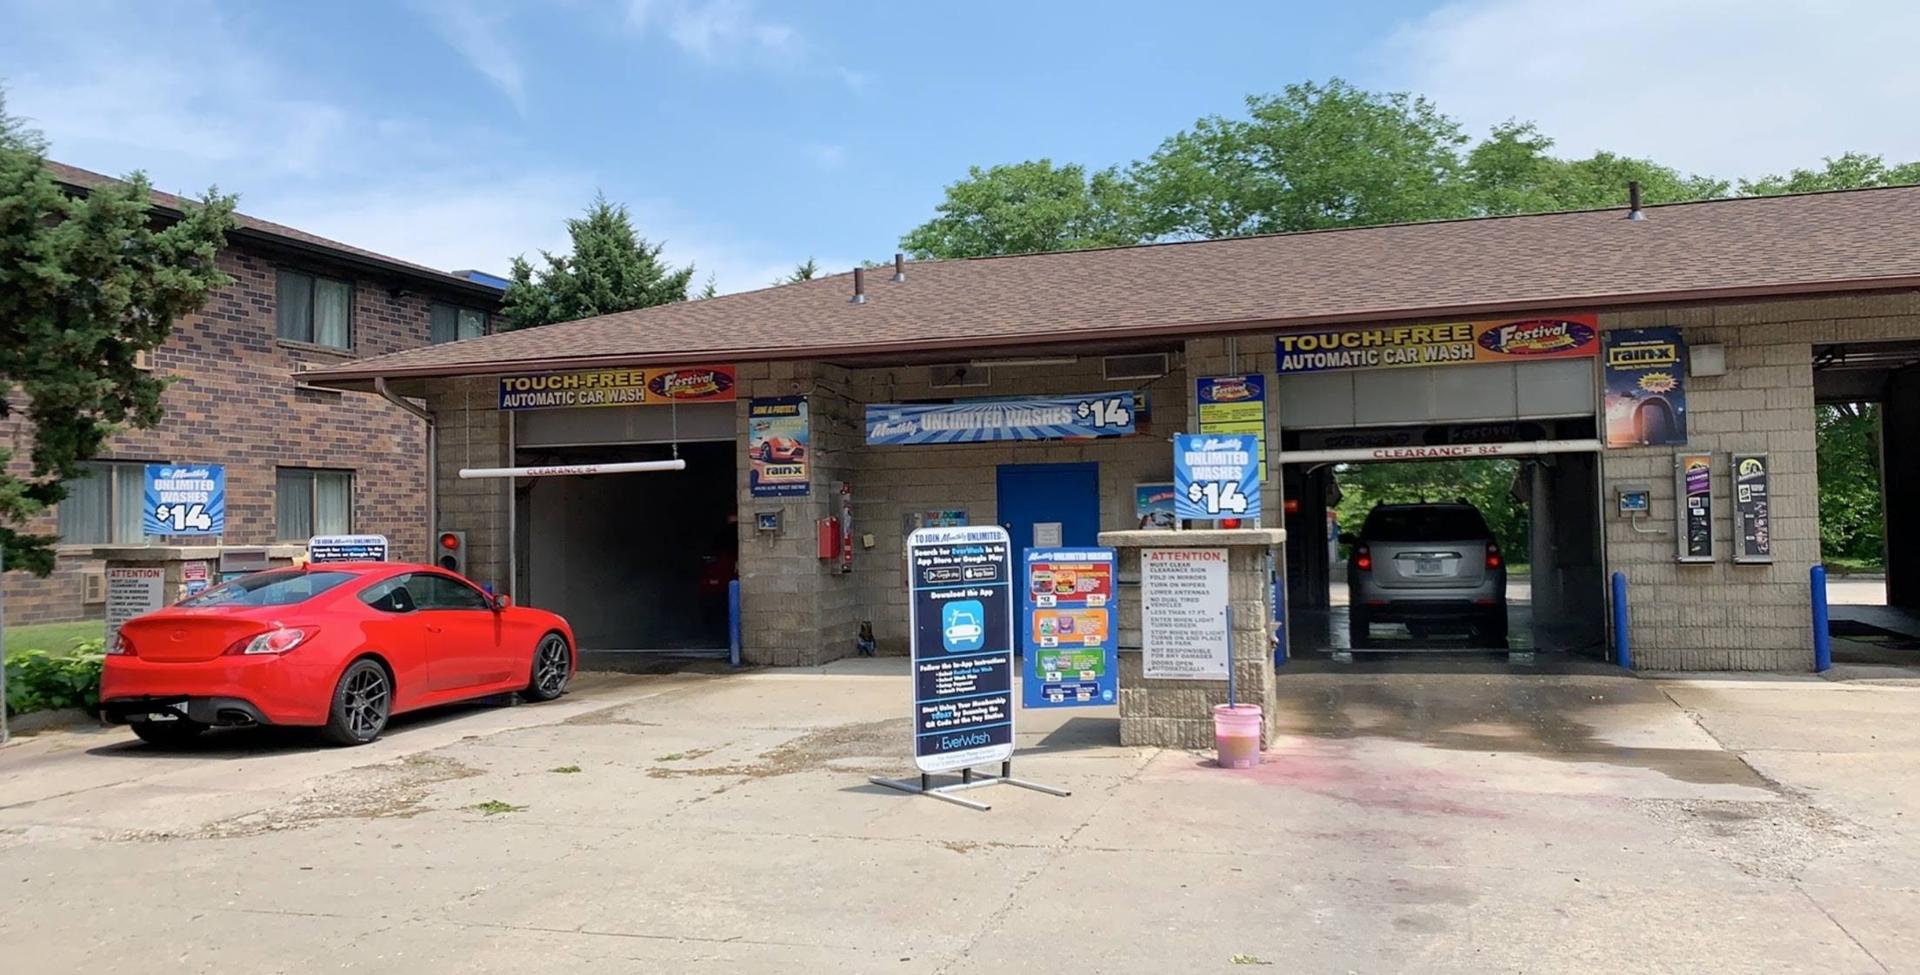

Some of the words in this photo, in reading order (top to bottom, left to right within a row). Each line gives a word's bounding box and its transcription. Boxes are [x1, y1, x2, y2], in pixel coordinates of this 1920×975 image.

[1279, 324, 1473, 351] TOUCH-FREE
[1500, 322, 1568, 345] Festival
[1282, 348, 1378, 370] AUTOMATIC
[1384, 347, 1419, 364] CAR
[1424, 344, 1474, 362] WASH
[503, 372, 643, 391] TOUCH-FREE
[665, 372, 713, 390] Festival
[503, 390, 576, 407] AUTOMATIC
[579, 390, 604, 404] CAR
[608, 388, 644, 402] WASH
[872, 421, 917, 438] Monthly
[921, 412, 1000, 430] UNLIMITED
[1006, 408, 1071, 426] WASHES
[1077, 399, 1129, 427] $14
[1185, 452, 1248, 465] UNLIMITED
[1192, 466, 1242, 480] WASHES
[154, 479, 214, 490] UNLIMITED
[160, 492, 208, 502] WASHES
[1188, 481, 1248, 514] $14
[156, 503, 212, 531] $14
[916, 535, 923, 543] TO
[925, 534, 939, 542] JOIN
[963, 556, 986, 564] Google
[1152, 552, 1220, 560] ATTENTION
[111, 570, 159, 578] ATTENTION
[931, 590, 965, 599] Download
[972, 698, 1006, 707] Membership
[963, 707, 988, 716] Scanning
[942, 732, 990, 750] EverWash
